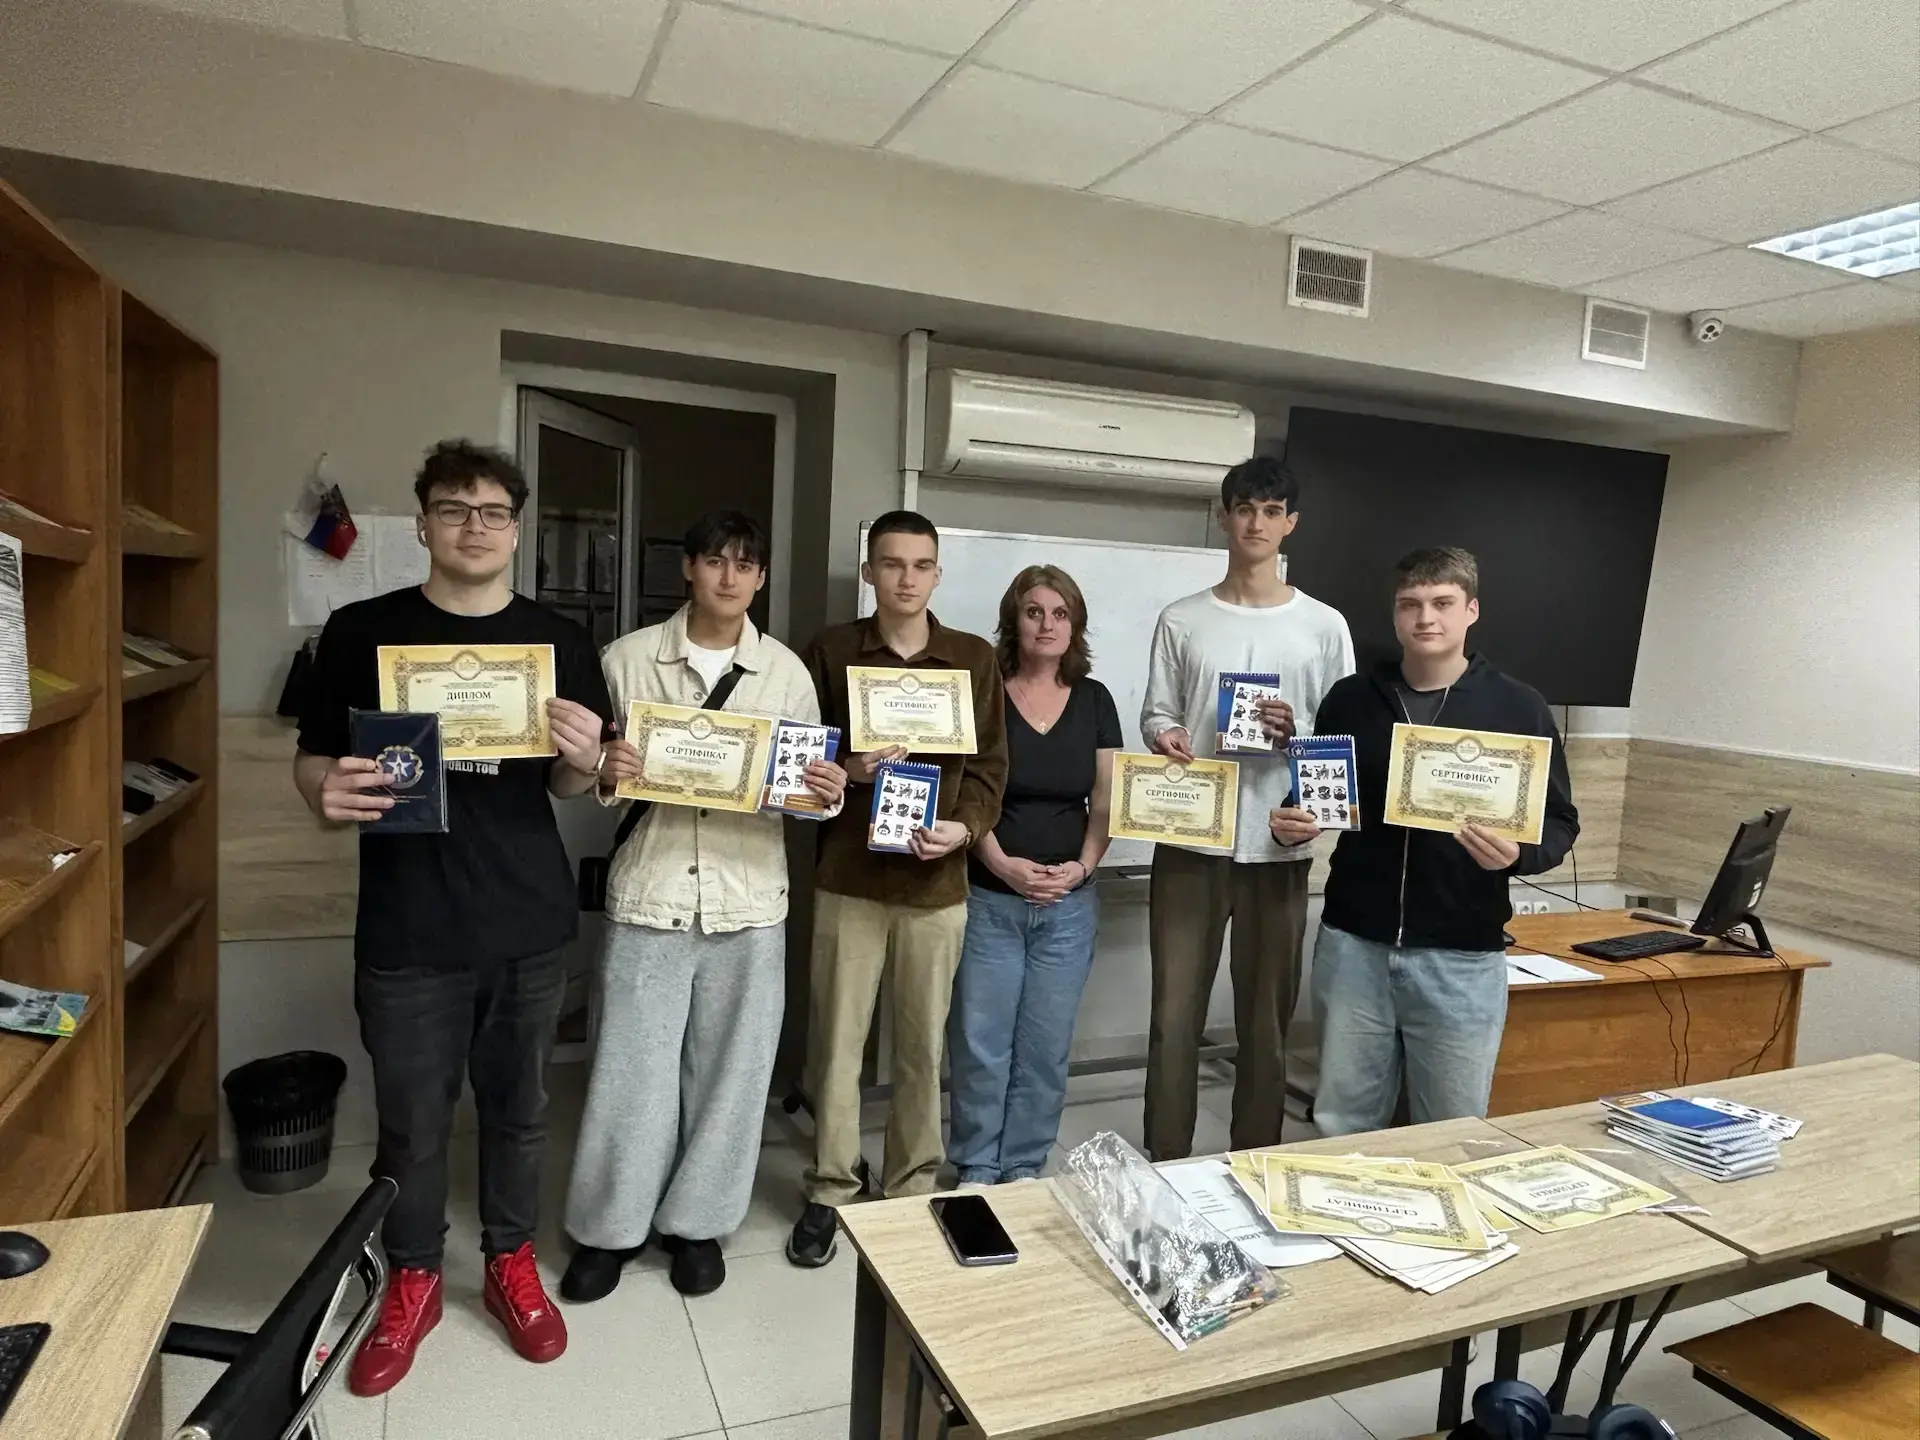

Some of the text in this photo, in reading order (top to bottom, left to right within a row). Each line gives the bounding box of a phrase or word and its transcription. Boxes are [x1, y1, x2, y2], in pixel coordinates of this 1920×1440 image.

[446, 691, 492, 702] ДИПЛОМ
[884, 700, 939, 710] СЕРТИФИКАТ
[665, 745, 728, 760] СЕРТИФИКАТ
[448, 760, 474, 773] ORLD
[1431, 768, 1501, 785] СЕРТИФИКАТ
[1145, 789, 1201, 801] СЕРТИФИКАТ
[1326, 1197, 1418, 1217] СЕРТИФИКАТ
